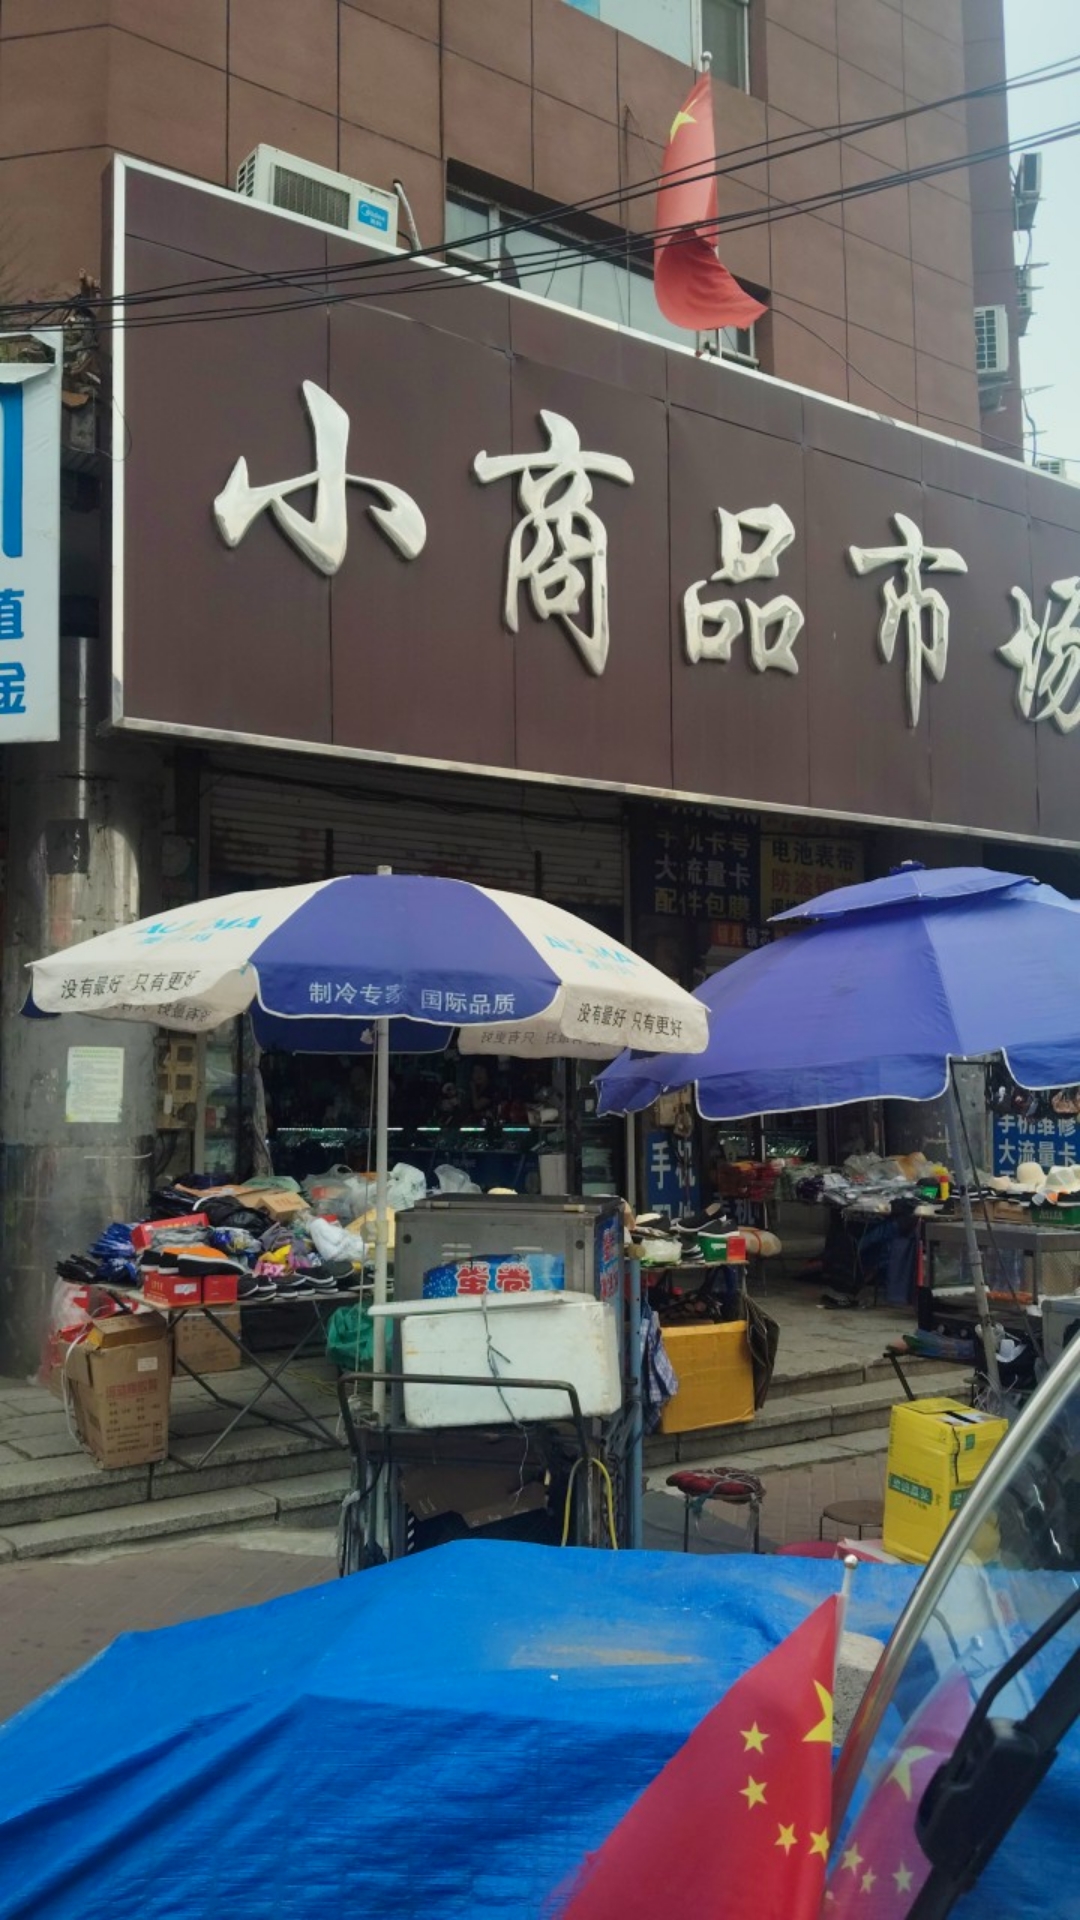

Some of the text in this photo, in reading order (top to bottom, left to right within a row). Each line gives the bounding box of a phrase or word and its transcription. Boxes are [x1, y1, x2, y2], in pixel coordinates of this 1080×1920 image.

[213, 379, 1080, 734] 小商品市场
[654, 853, 751, 890] 大流量卡
[654, 886, 751, 921] 配件包膜
[61, 970, 201, 999] 没有最好 只有更好
[308, 981, 516, 1015] 制冷专家 国际品质
[576, 1002, 683, 1038] 没有最好 只有更好
[997, 1114, 1077, 1137] 手机维修
[998, 1138, 1077, 1167] 大流量卡
